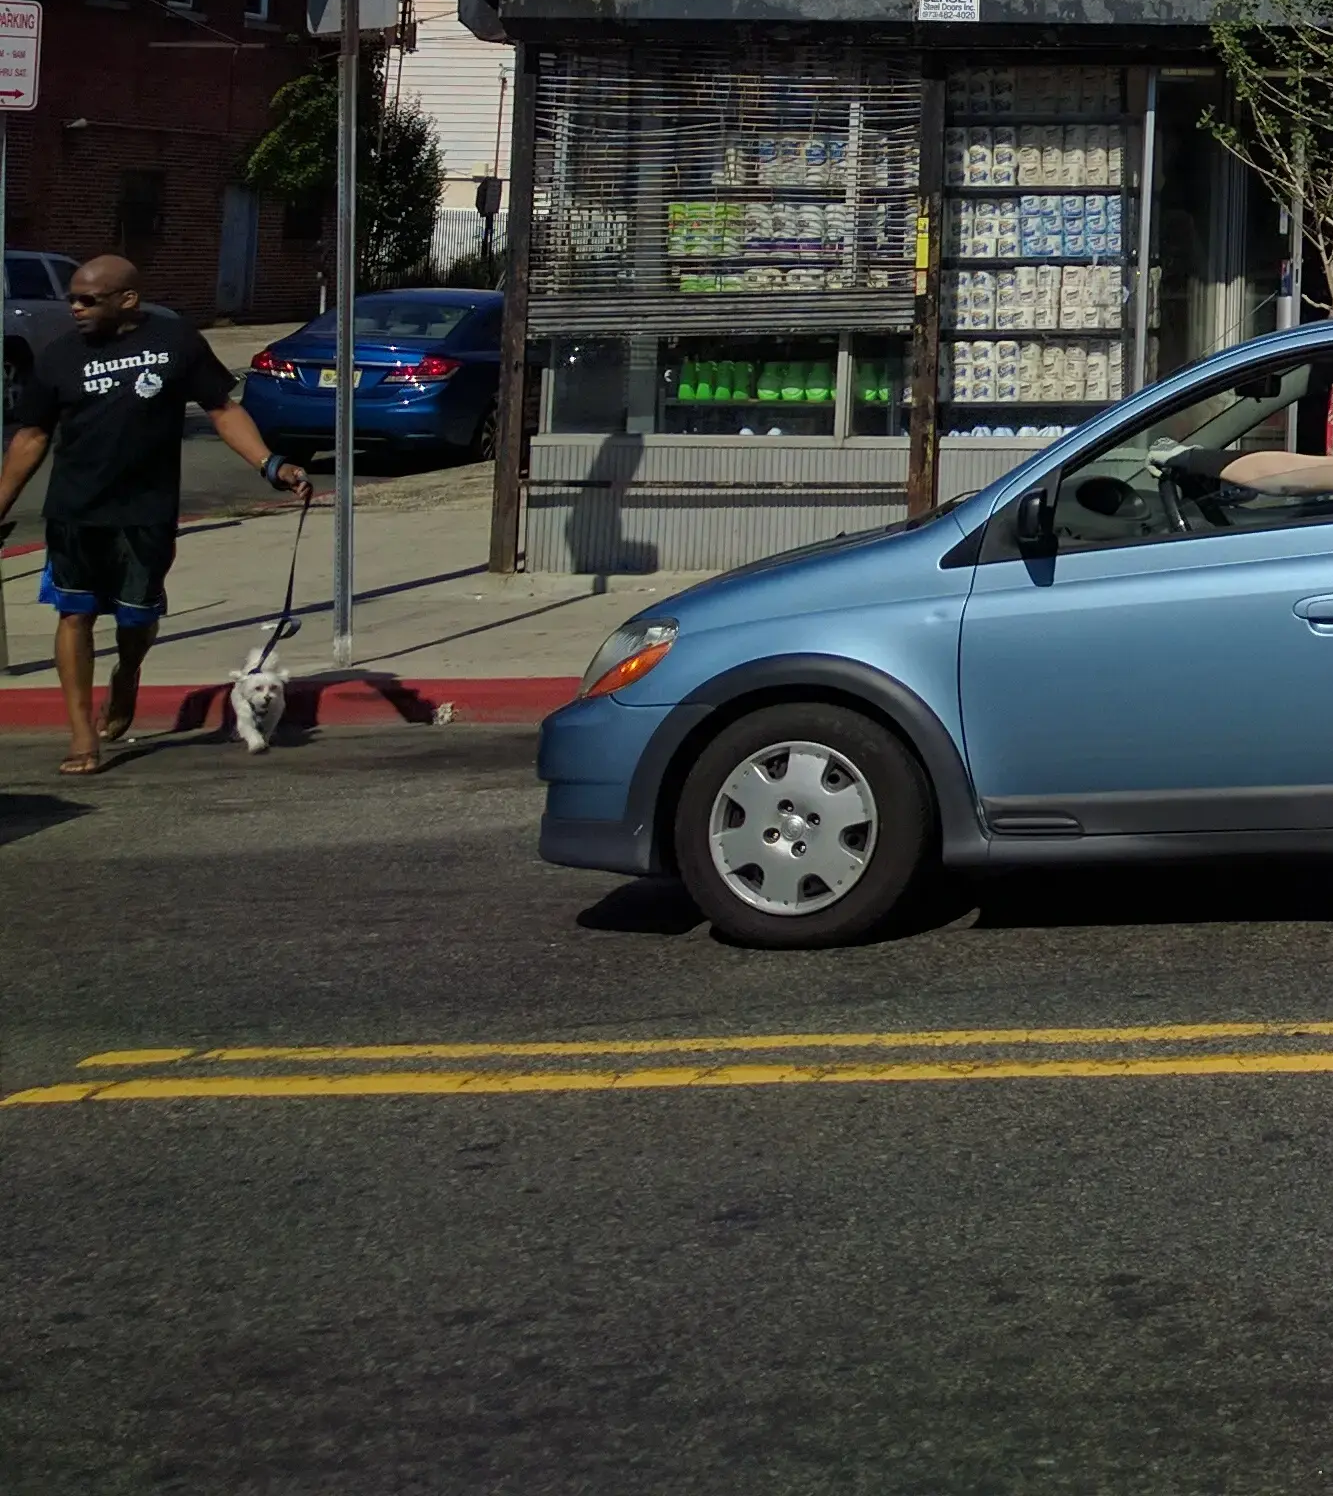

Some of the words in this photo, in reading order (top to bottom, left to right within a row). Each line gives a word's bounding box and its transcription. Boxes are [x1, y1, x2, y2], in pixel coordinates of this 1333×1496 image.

[923, 3, 940, 11] Steel
[941, 3, 962, 11] Doors
[83, 350, 170, 378] thumbs
[83, 376, 121, 395] up.
